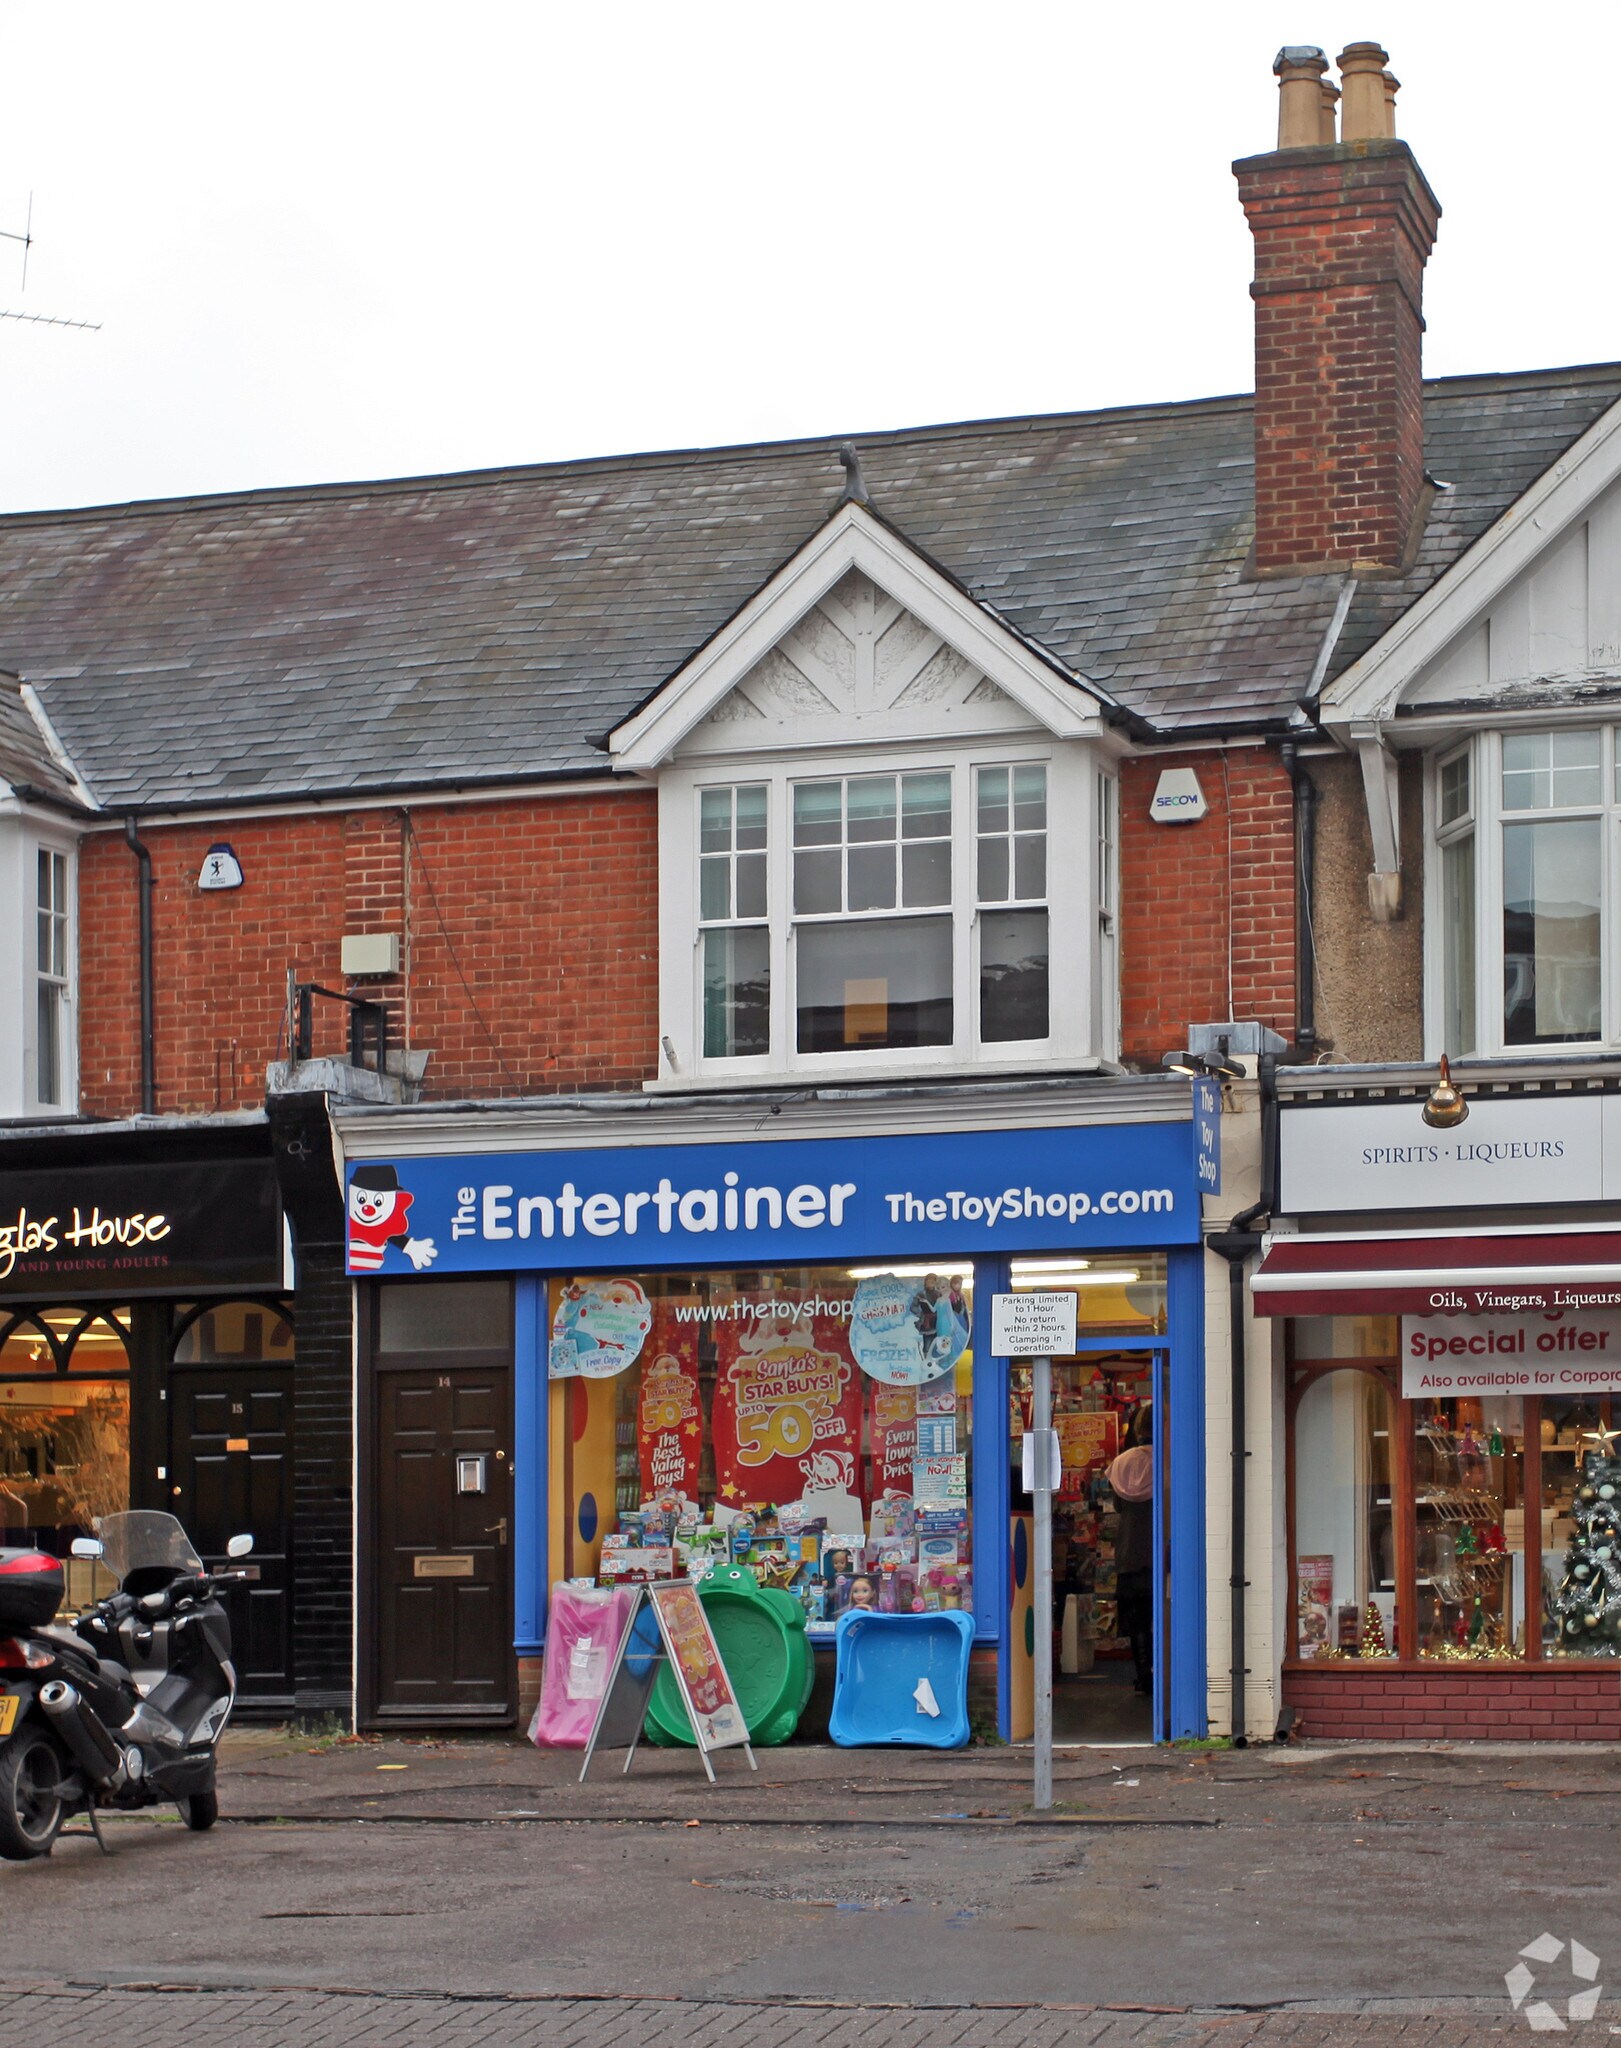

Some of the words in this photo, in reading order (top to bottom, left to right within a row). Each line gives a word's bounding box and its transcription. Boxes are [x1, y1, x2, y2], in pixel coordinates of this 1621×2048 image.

[1156, 795, 1198, 807] SECOM
[1200, 1085, 1214, 1113] The
[1201, 1121, 1214, 1154] Toy
[1362, 1145, 1438, 1165] SPIRITS
[1456, 1141, 1564, 1164] LIQUEURS
[1198, 1153, 1216, 1187] Shop
[451, 1186, 477, 1241] The
[483, 1171, 857, 1241] Entertainer
[885, 1187, 1174, 1228] TheToyShop.com
[65, 1207, 171, 1248] House
[19, 1261, 49, 1273] AND
[56, 1258, 107, 1272] YOUNG
[113, 1255, 169, 1269] ADULTS
[1002, 1296, 1035, 1305] Parking
[1039, 1295, 1069, 1304] limited
[1033, 1305, 1056, 1313] Hour.
[1429, 1292, 1467, 1310] Oils,
[1475, 1291, 1547, 1310] Vinegars,
[1003, 1325, 1030, 1333] within
[1033, 1324, 1039, 1332] 2
[1041, 1324, 1067, 1332] hours.
[1009, 1335, 1050, 1344] Clamping
[1410, 1328, 1525, 1361] Special
[1536, 1326, 1610, 1353] offer
[757, 1353, 817, 1380] Santa's
[438, 1376, 450, 1387] 14
[745, 1383, 784, 1400] STAR
[787, 1374, 834, 1394] BUYS!
[1420, 1374, 1453, 1388] Also
[1457, 1371, 1530, 1387] available
[1534, 1370, 1556, 1384] for
[232, 1403, 243, 1414] 15
[814, 1420, 845, 1438] OFF!
[885, 1429, 915, 1446] Even
[659, 1432, 679, 1449] The
[653, 1445, 682, 1462] Best
[651, 1457, 685, 1475] Value
[653, 1467, 684, 1488] Toys!
